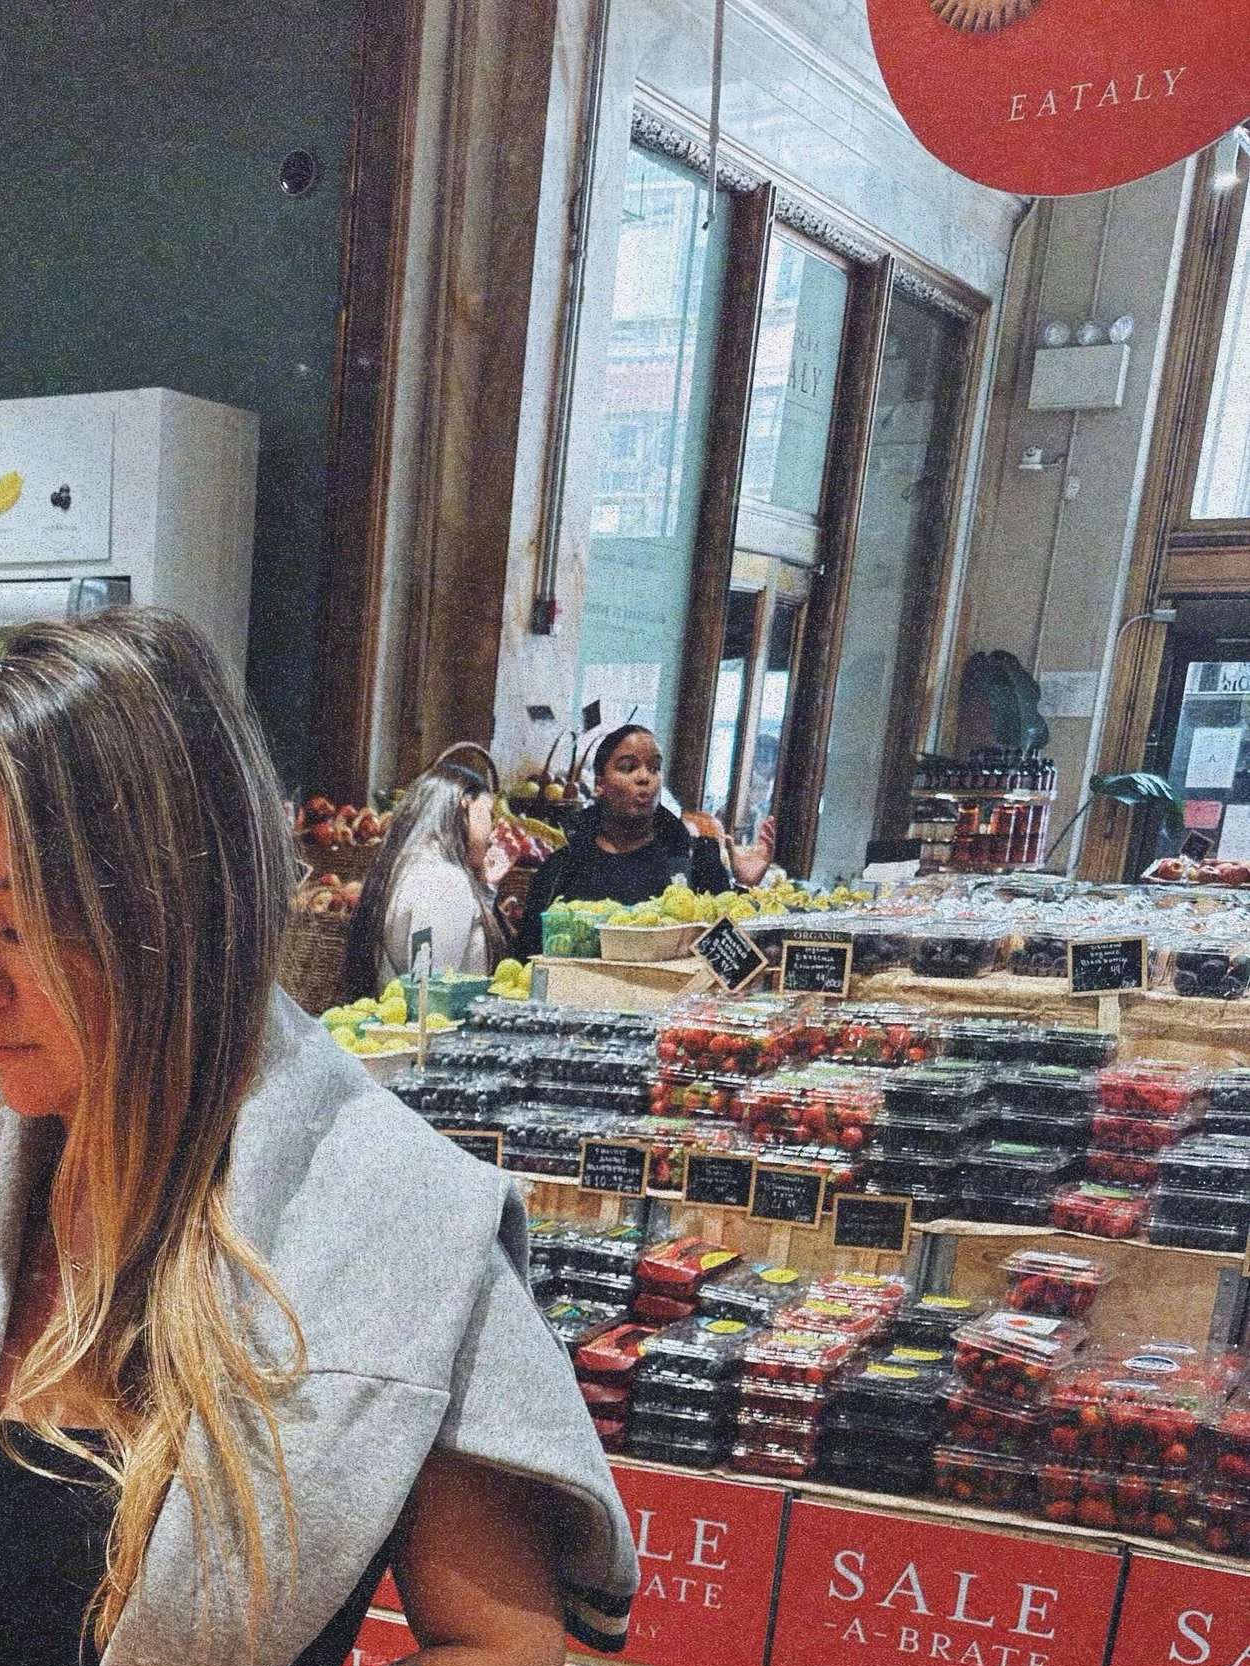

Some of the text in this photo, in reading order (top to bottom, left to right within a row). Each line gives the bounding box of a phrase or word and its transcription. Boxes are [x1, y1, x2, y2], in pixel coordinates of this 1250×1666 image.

[1008, 66, 1187, 122] EATALY
[793, 931, 846, 941] ORGANIC
[636, 1509, 730, 1570] LE
[828, 1549, 1059, 1640] SALE
